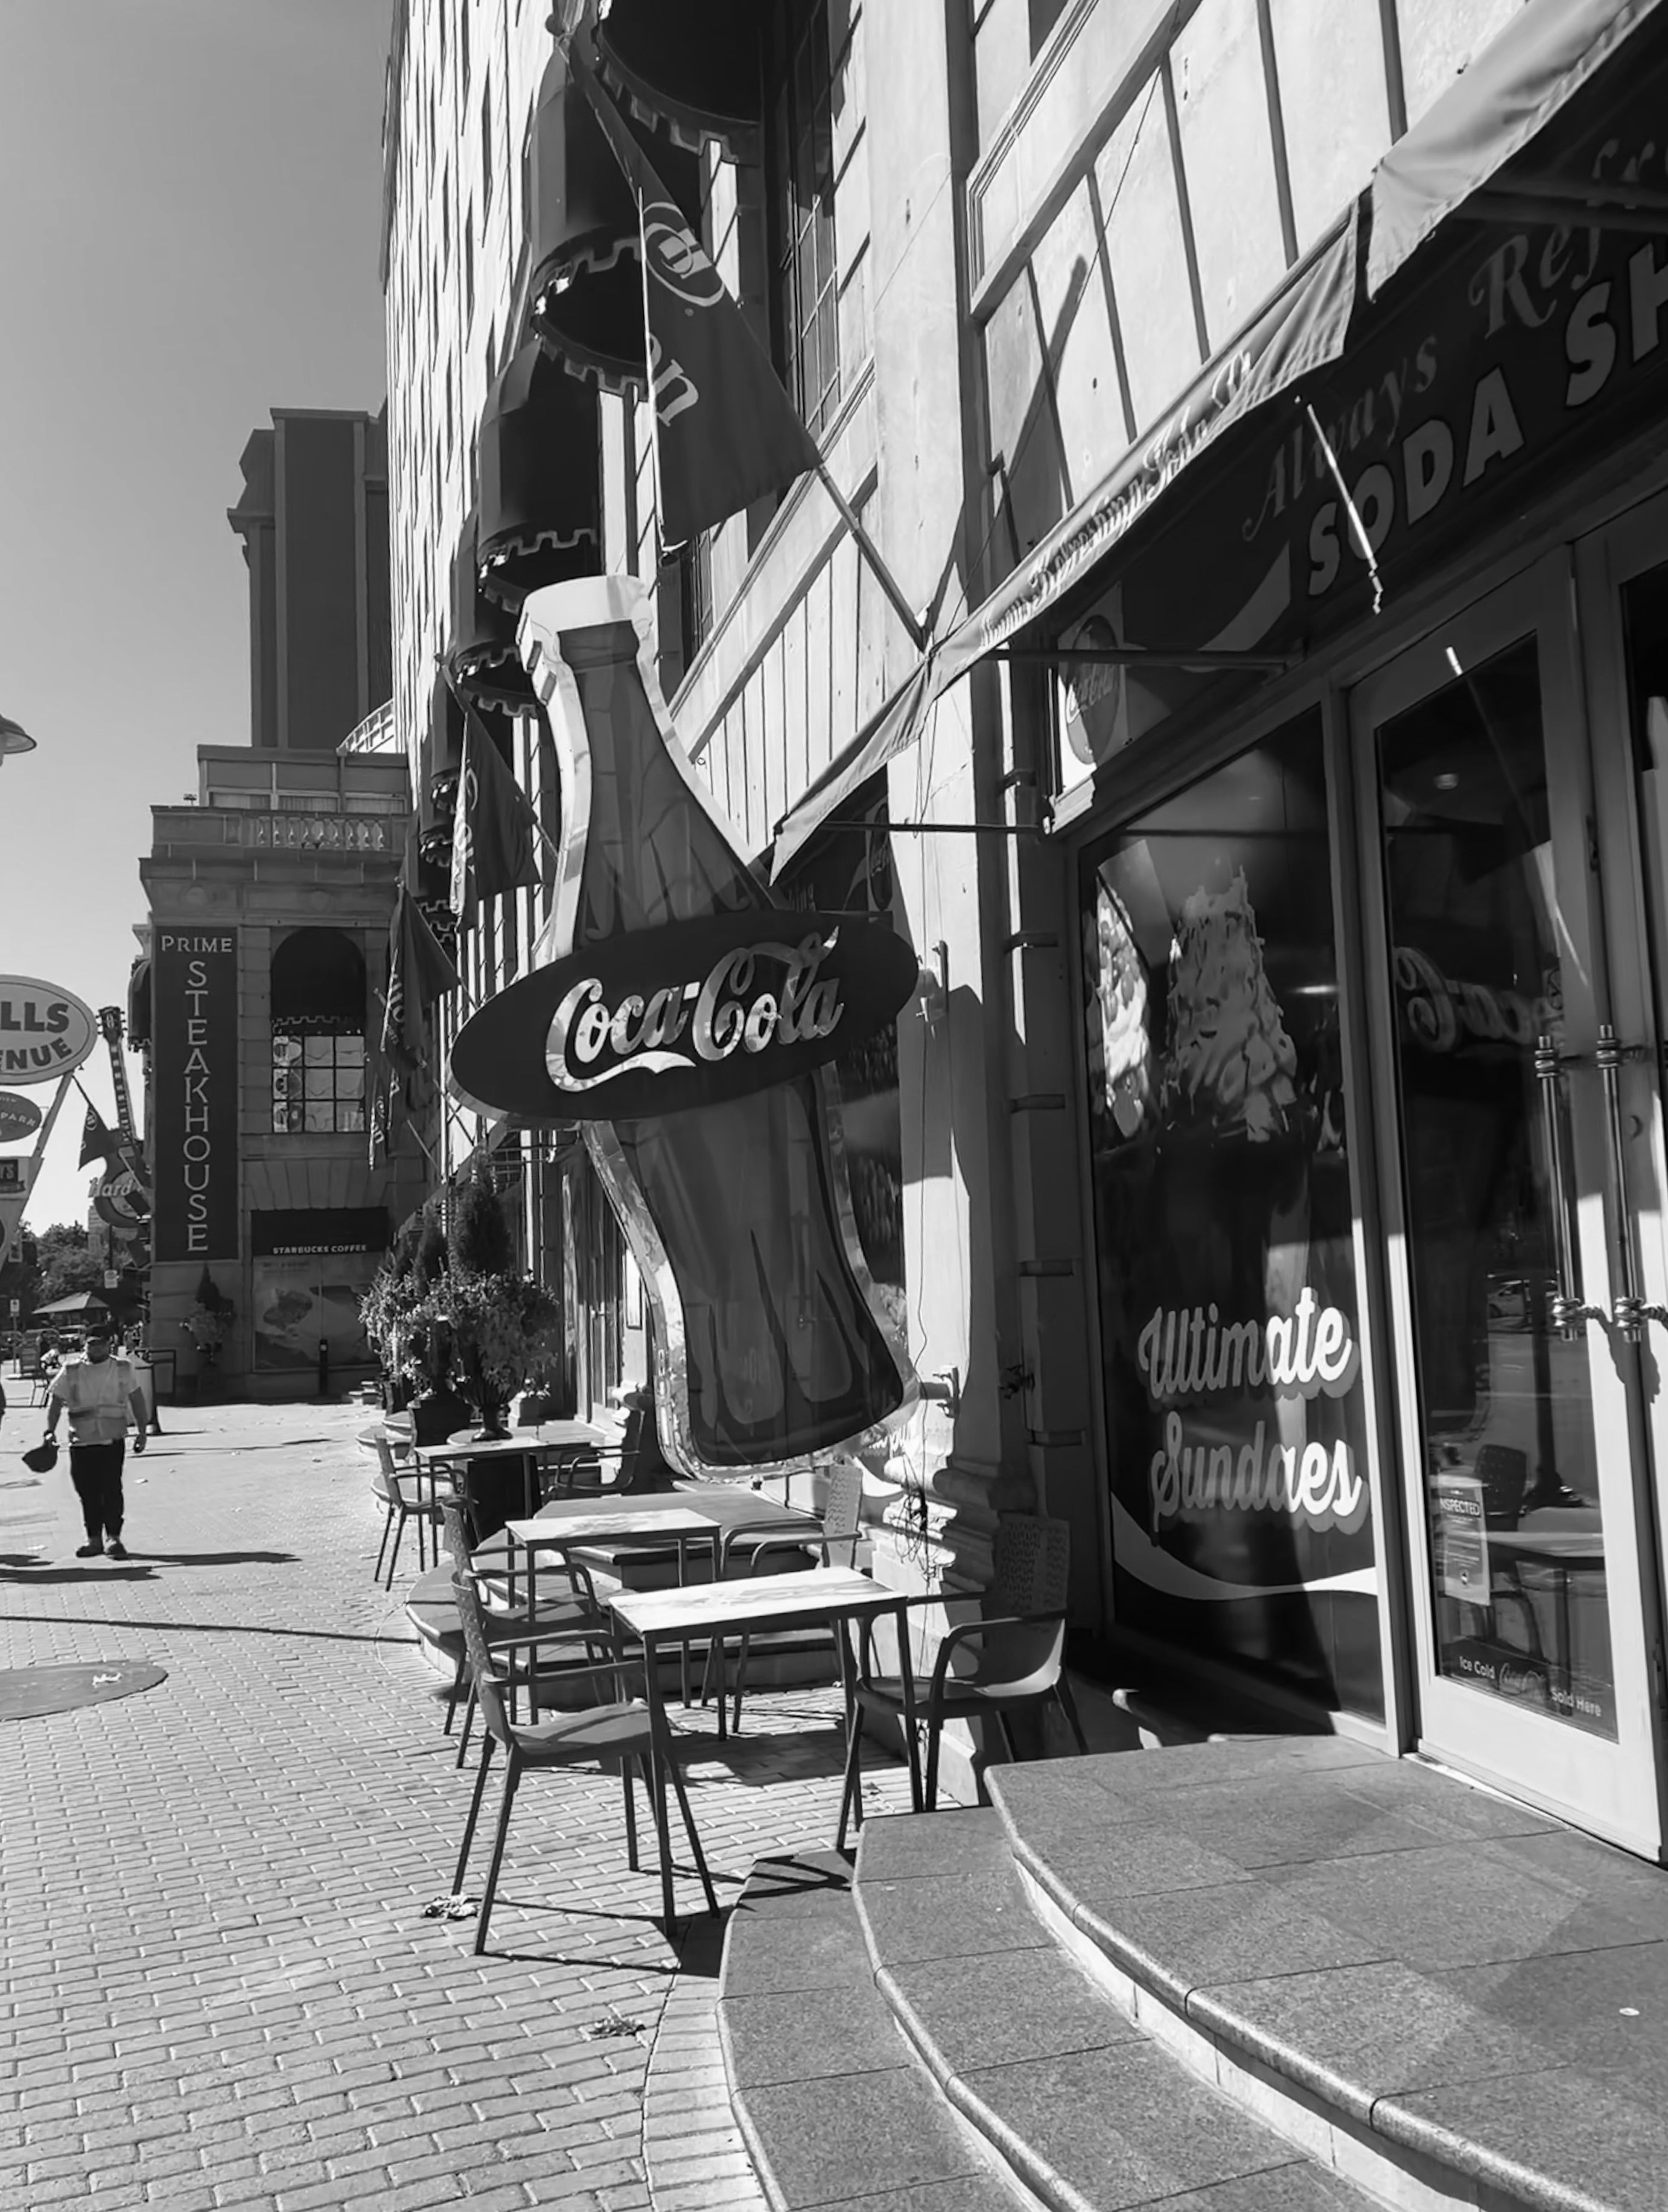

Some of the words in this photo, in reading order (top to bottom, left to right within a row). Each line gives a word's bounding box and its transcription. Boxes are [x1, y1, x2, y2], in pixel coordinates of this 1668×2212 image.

[1308, 367, 1526, 597] SODA
[161, 935, 233, 953] PRIME
[546, 925, 844, 1092] Coca-Cola
[183, 960, 211, 1251] STEAKHOUSE
[88, 1176, 134, 1197] Hard
[273, 1246, 329, 1254] STARBUCKS
[331, 1245, 367, 1253] COFFEE
[1138, 1286, 1358, 1400] Ultimate
[1151, 1410, 1365, 1533] Sundaes
[1459, 1656, 1473, 1671] Ice
[1474, 1660, 1495, 1679] Cold
[1551, 1686, 1575, 1707] Sold
[1576, 1695, 1602, 1716] Here
